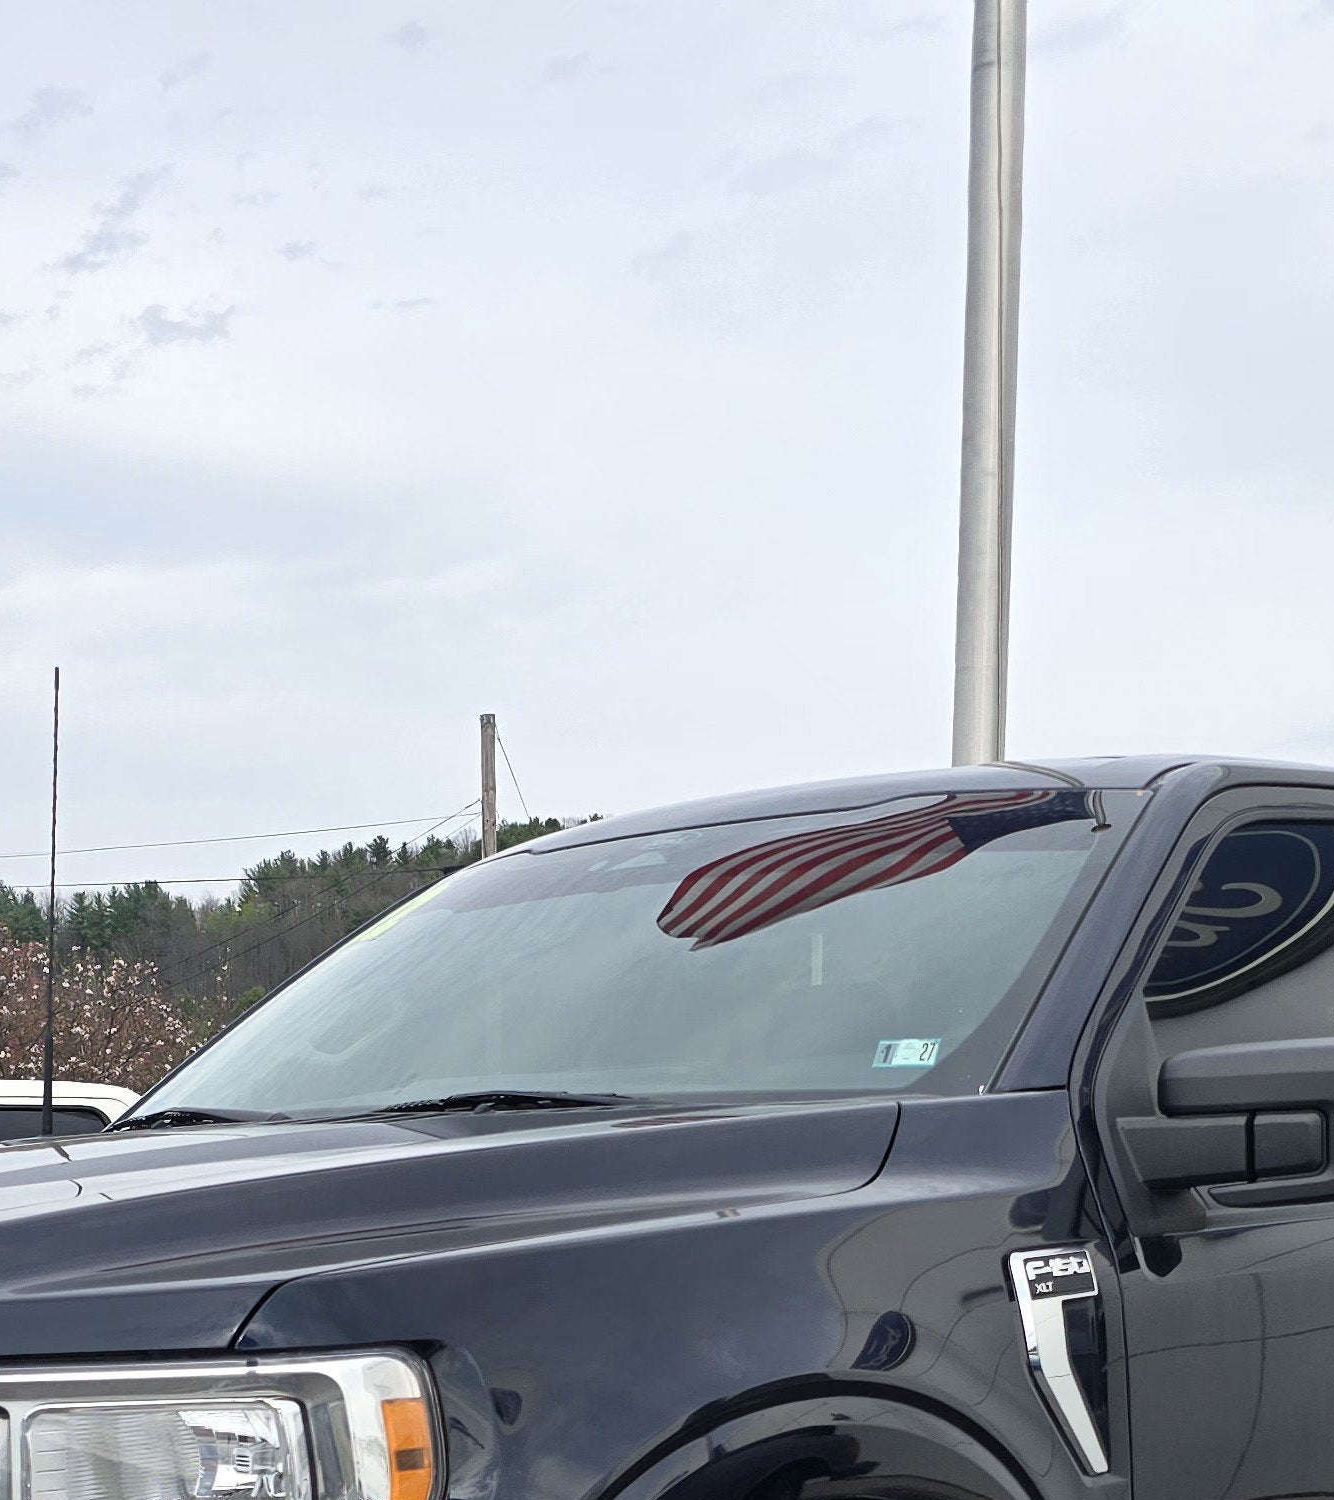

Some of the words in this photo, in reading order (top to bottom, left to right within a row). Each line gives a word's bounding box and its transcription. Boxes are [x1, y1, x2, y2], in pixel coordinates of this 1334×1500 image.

[919, 1042, 937, 1062] 27
[1025, 1256, 1091, 1281] F-150
[1034, 1281, 1054, 1294] XLT
